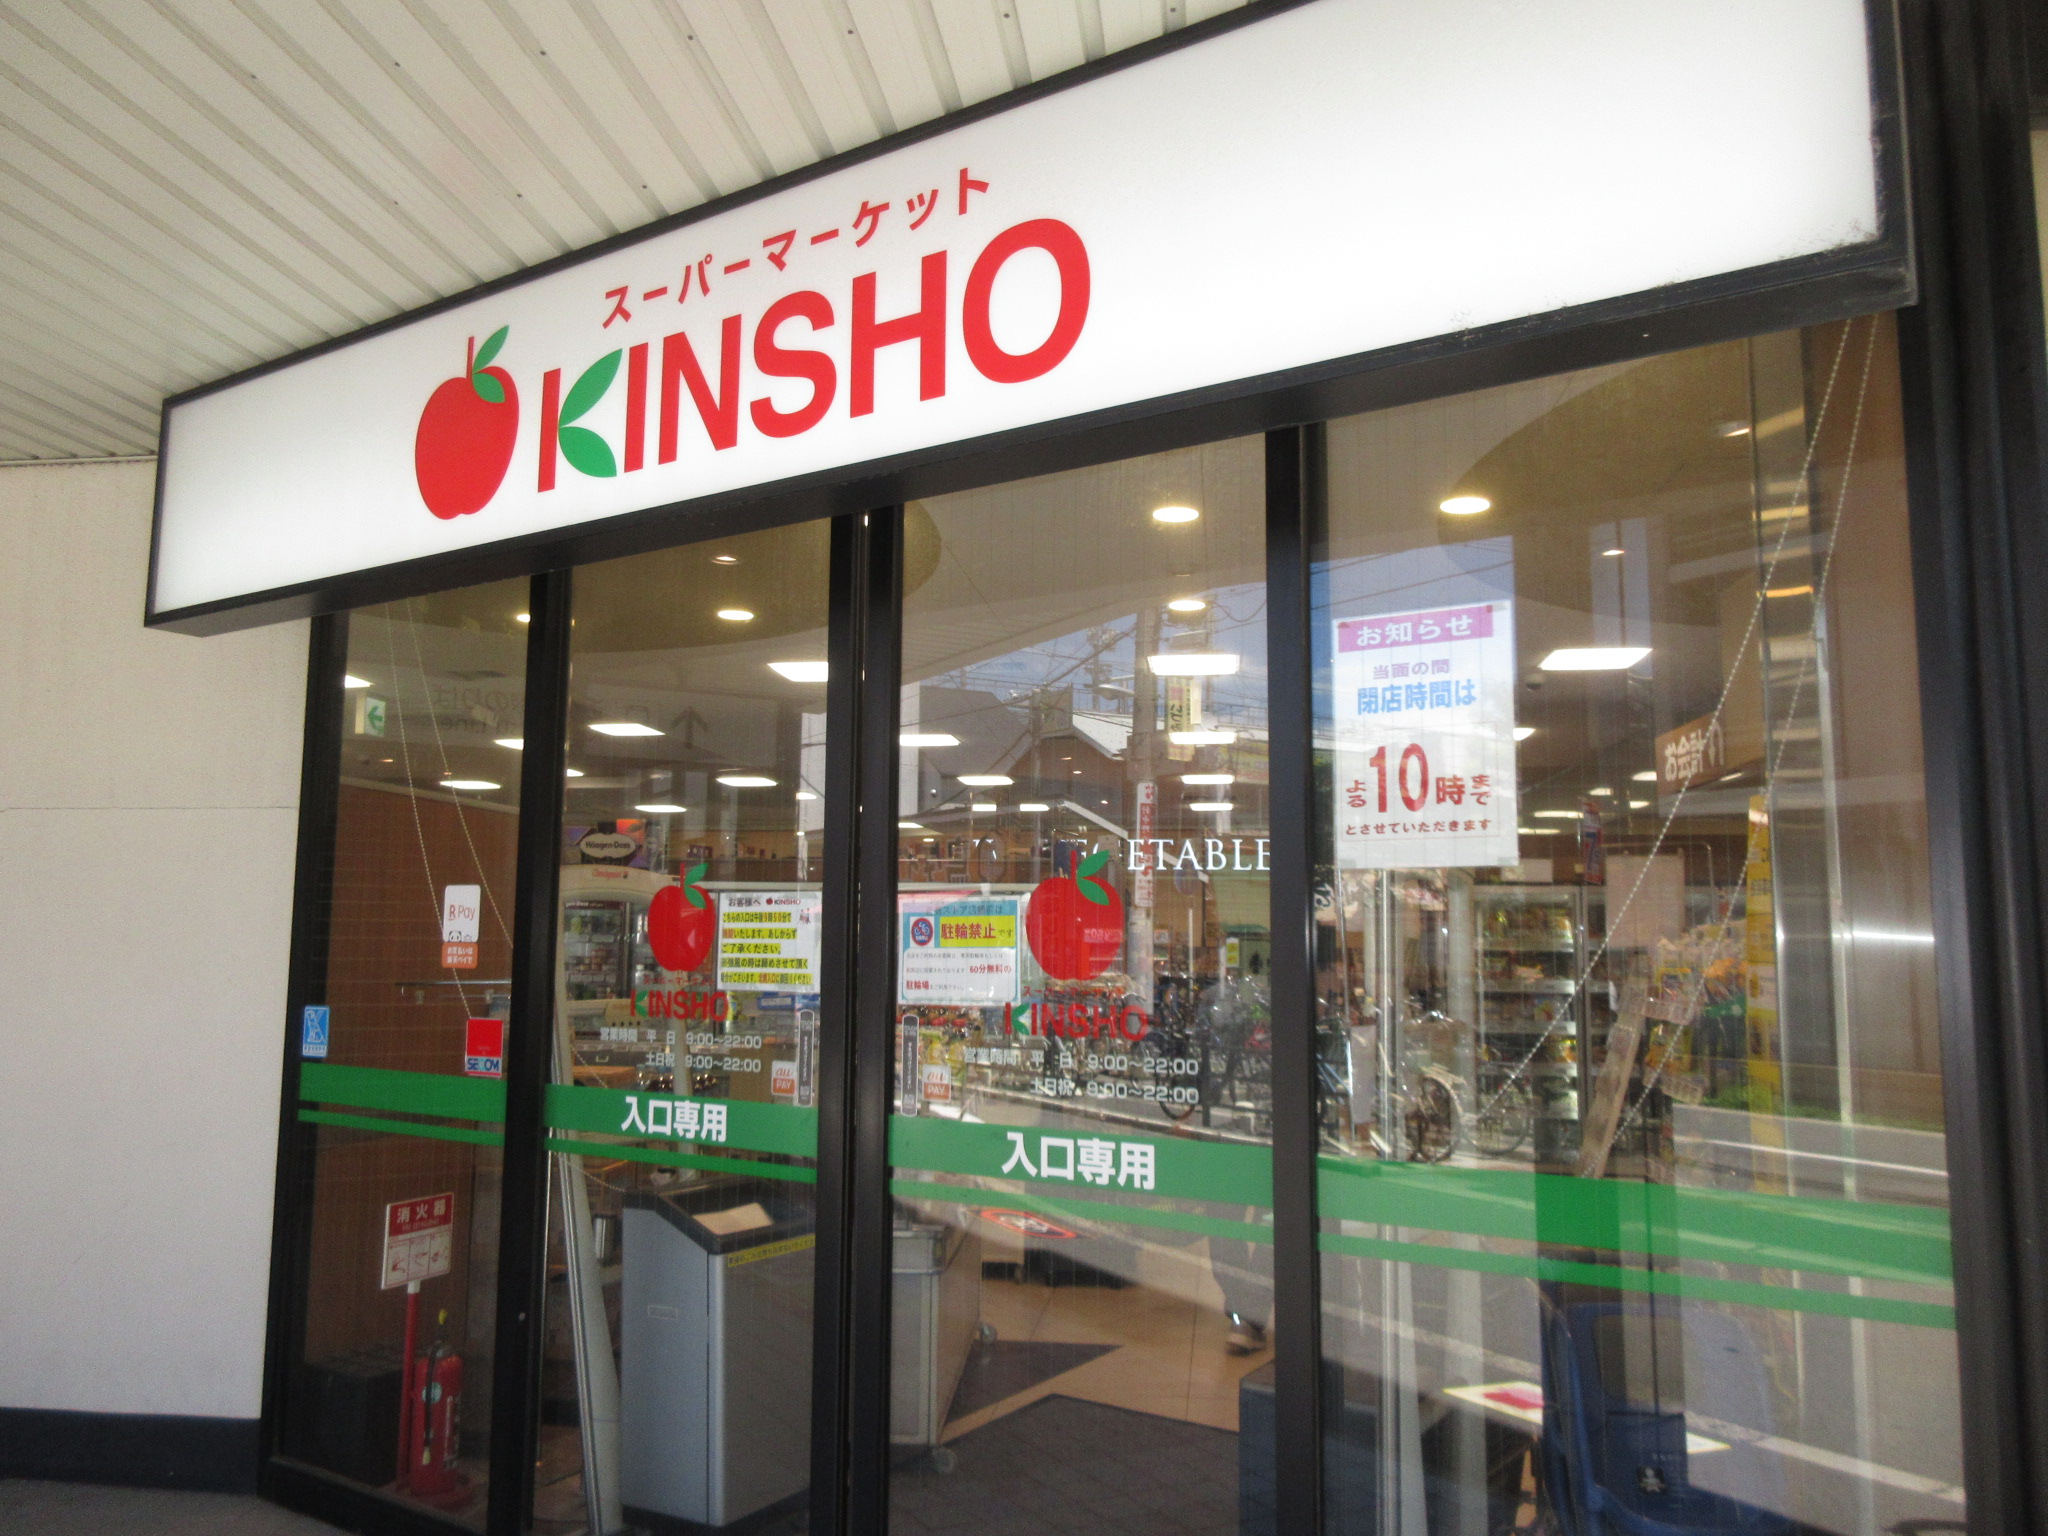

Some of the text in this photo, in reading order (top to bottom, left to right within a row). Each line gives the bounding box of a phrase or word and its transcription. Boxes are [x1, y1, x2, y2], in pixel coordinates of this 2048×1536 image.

[602, 167, 990, 329] スーパーマーケット
[538, 217, 1091, 494] KINSHO
[1356, 615, 1473, 647] お知らせ
[1373, 659, 1450, 680] 当面の間
[1357, 678, 1477, 716] 閉店時間は
[1346, 818, 1492, 836] とさせていただきます
[1077, 838, 1270, 871] ETABLE
[728, 897, 761, 908] お客様へ
[773, 897, 801, 906] KINSHO
[458, 905, 476, 920] Pay
[969, 964, 1012, 975] 60分無料の
[630, 988, 729, 1022] KINSHO
[1005, 1002, 1149, 1042] KINSHO
[600, 1027, 638, 1044] 営業時間
[467, 1057, 500, 1072] SECOM
[645, 1052, 676, 1068] 土日祝
[964, 1045, 1018, 1067] 営業時間
[775, 1067, 792, 1077] au
[926, 1071, 945, 1083] au
[775, 1079, 792, 1090] PAY
[927, 1085, 945, 1096] PAY
[1030, 1077, 1073, 1097] 土日祝
[621, 1095, 728, 1142] 入口専用
[1001, 1131, 1156, 1191] 入口専用
